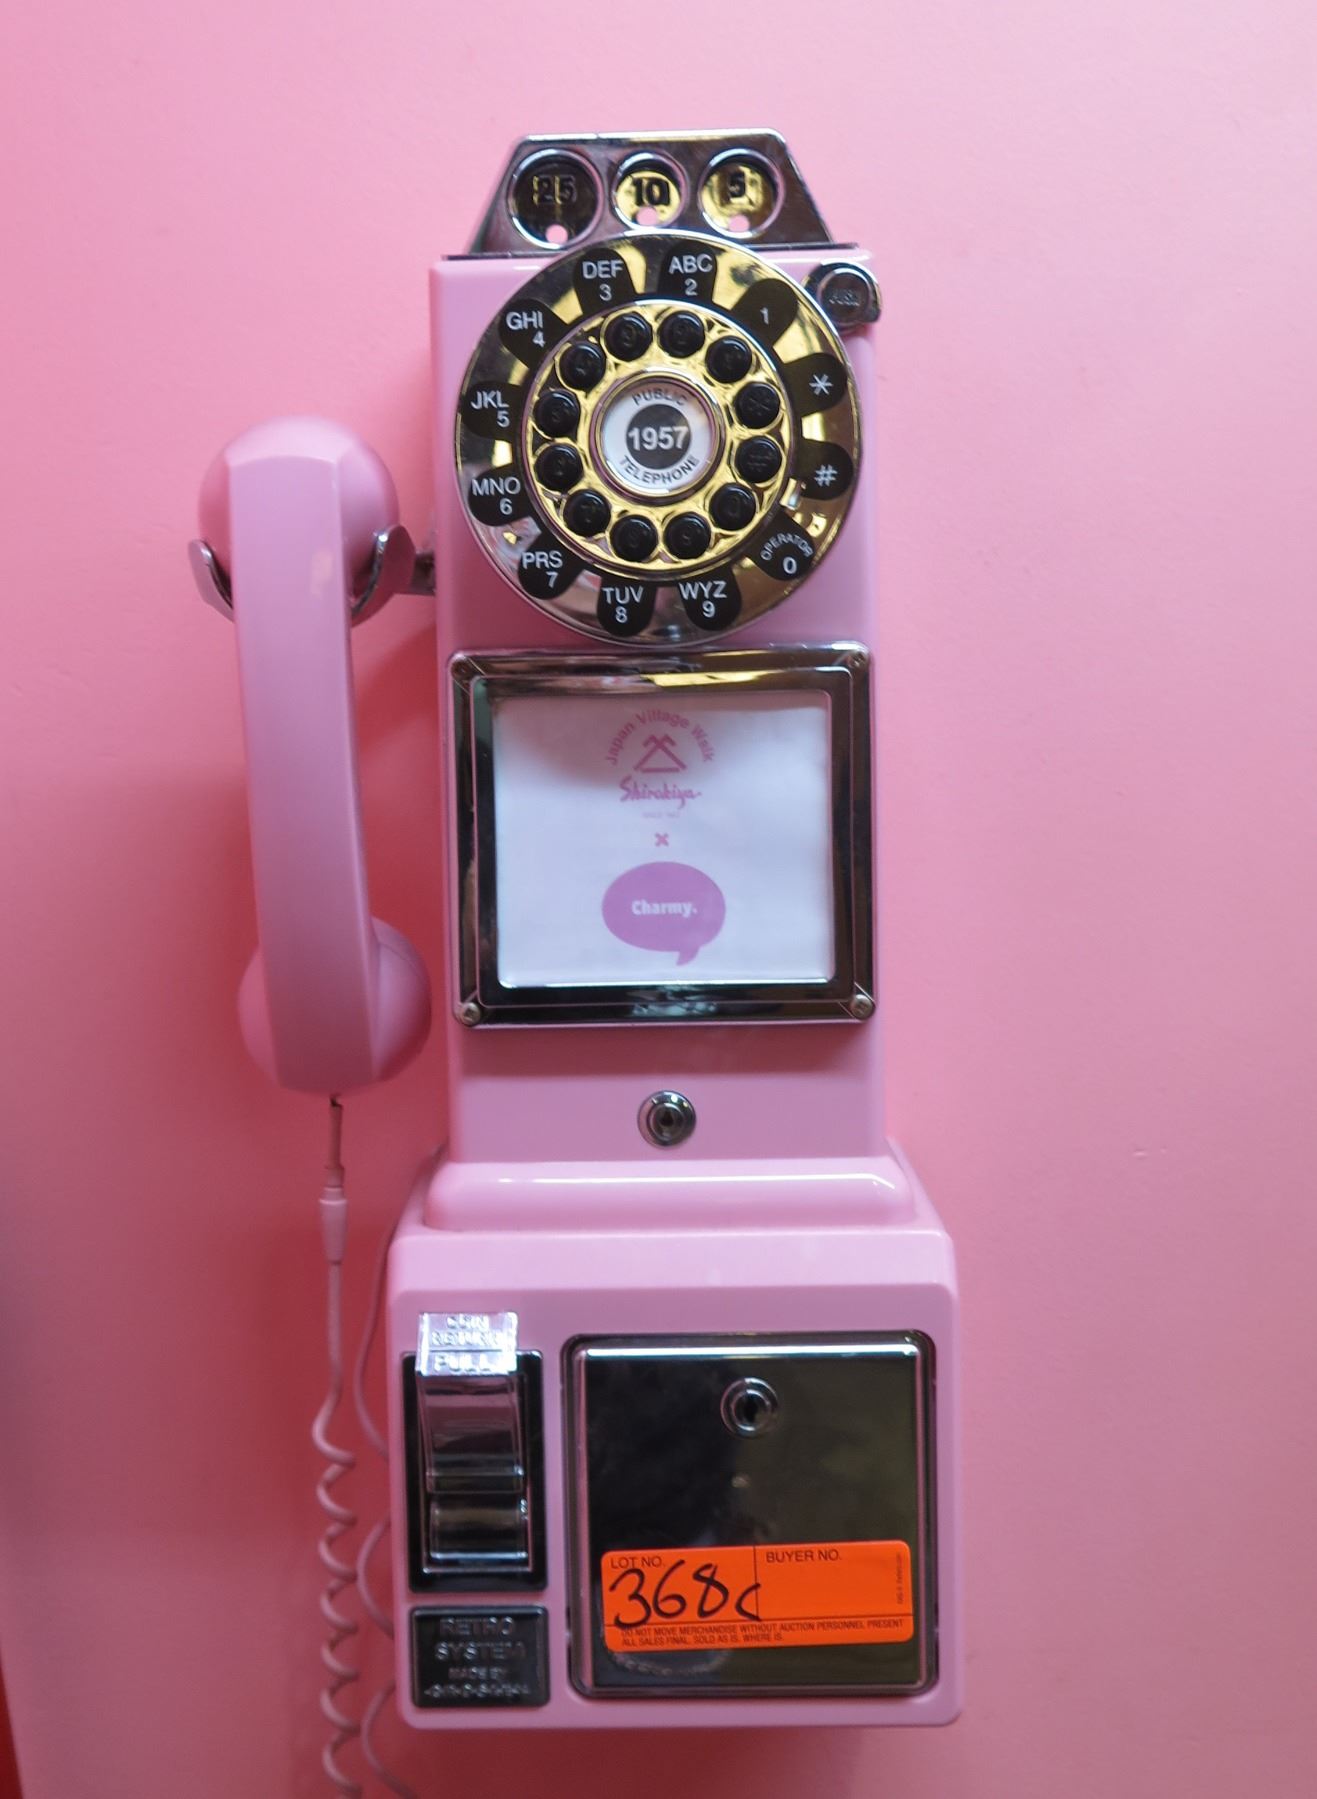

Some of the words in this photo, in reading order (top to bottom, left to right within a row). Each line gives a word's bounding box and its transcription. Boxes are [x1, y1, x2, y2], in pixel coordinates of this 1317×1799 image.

[632, 178, 671, 207] 10
[582, 259, 624, 279] DEF
[668, 254, 713, 274] ABC
[599, 284, 612, 301] 3
[685, 279, 698, 296] 2
[505, 311, 543, 330] GHI
[760, 308, 770, 324] 1
[532, 331, 545, 347] 4
[470, 390, 509, 410] JKL
[632, 388, 688, 406] PUBLIC
[496, 410, 510, 427] 5
[628, 426, 689, 451] 1957
[620, 455, 700, 484] TELEPHONE
[814, 464, 838, 487] #
[471, 477, 521, 496] MNO
[499, 499, 513, 515] 6
[760, 532, 814, 561] OPERATOR
[521, 551, 563, 569] PRS
[782, 556, 797, 575] 0
[546, 571, 559, 588] 7
[602, 586, 644, 604] TUV
[678, 580, 727, 600] WYZ
[614, 606, 627, 623] 8
[702, 601, 716, 618] 9
[605, 721, 637, 766] Japan
[635, 709, 690, 728] Village
[610, 1557, 638, 1569] LOT
[641, 1555, 666, 1567] NO.
[766, 1551, 814, 1563] BUYER
[818, 1549, 842, 1561] NO.
[635, 1627, 651, 1638] NOT
[654, 1626, 676, 1637] MOVE
[679, 1624, 737, 1636] MERCHANDISE
[740, 1622, 777, 1633] WITHOUT
[780, 1621, 815, 1632] AUCTION
[817, 1620, 864, 1631] PERSONNEL
[867, 1618, 903, 1629] PRESENT
[622, 1637, 637, 1647] ALL
[639, 1636, 664, 1646] SALES
[694, 1634, 715, 1644] SOLD
[718, 1633, 729, 1643] AS
[743, 1632, 771, 1642] WHERE
